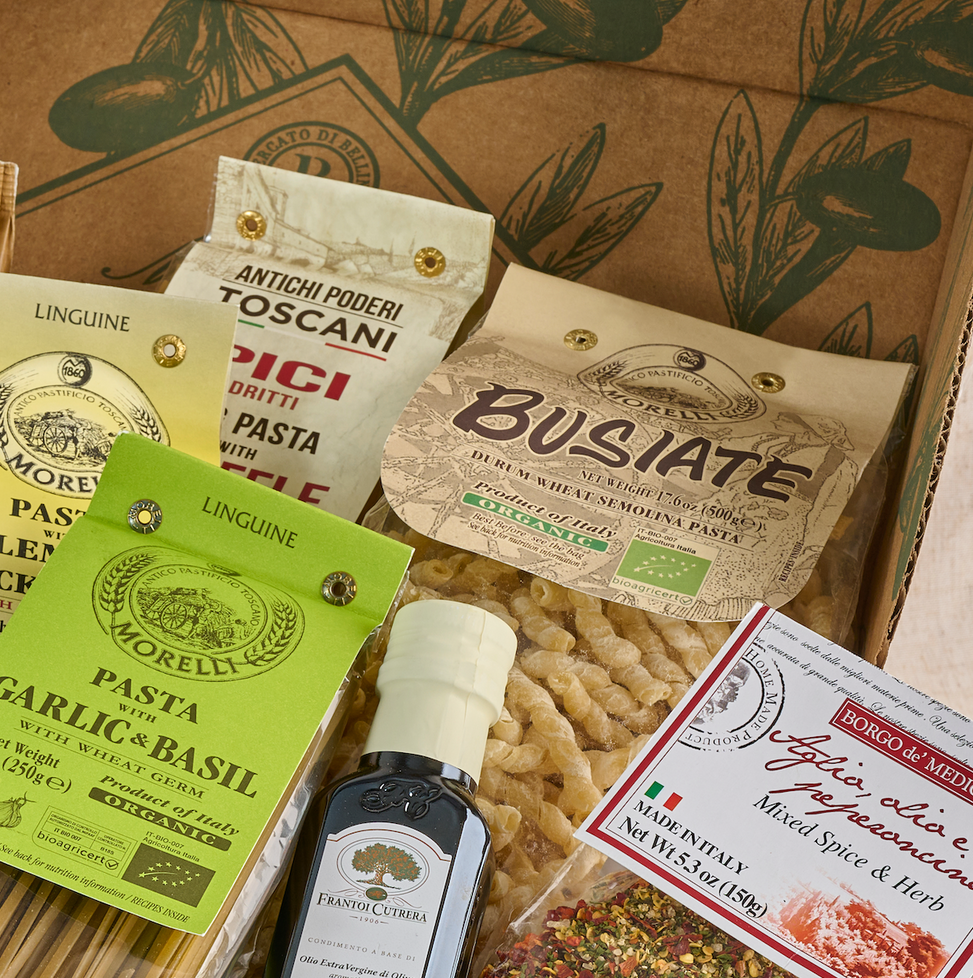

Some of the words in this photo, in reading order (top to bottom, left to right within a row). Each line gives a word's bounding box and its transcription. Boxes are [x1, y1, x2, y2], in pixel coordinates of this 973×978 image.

[253, 129, 311, 165] ERCATO
[316, 129, 338, 144] DI
[235, 265, 324, 300] ANTICHI
[323, 285, 403, 321] PODERI
[34, 302, 130, 333] LINGUINE
[219, 285, 397, 353] TOSCANI
[38, 390, 96, 405] PASTIFICIO
[228, 380, 299, 410] DRITTI
[603, 389, 719, 422] MORELLI
[232, 412, 320, 455] PASTA
[452, 381, 813, 501] BUSIATE
[6, 452, 99, 494] MORE
[579, 470, 604, 483] NET
[607, 478, 654, 498] WEIGHT
[471, 450, 530, 480] DURUM
[536, 477, 594, 501] WHEAT
[597, 495, 682, 527] SEMOLINA
[689, 522, 739, 544] PASTA
[474, 482, 545, 514] Product
[548, 513, 572, 524] of
[571, 519, 617, 538] Italy
[201, 496, 298, 549] LINGUINE
[479, 499, 592, 547] ORGANIC
[179, 567, 241, 589] PASTIFICIO
[612, 577, 679, 600] bioagricert
[112, 621, 240, 676] MORELLI
[745, 649, 774, 686] HOME
[89, 667, 199, 725] PASTA
[117, 703, 156, 724] WITH
[751, 692, 778, 731] MADE
[685, 730, 752, 746] PRODUCT
[840, 708, 904, 751] BORGO
[15, 739, 61, 769] Weight
[20, 719, 71, 746] WITH
[78, 742, 146, 775] WHEAT
[151, 772, 206, 799] GERM
[130, 732, 148, 748] &
[148, 735, 259, 799] BASIL
[100, 775, 171, 808] Product
[172, 804, 193, 822] of
[195, 812, 240, 837] Italy
[104, 794, 217, 845] ORGANIC
[880, 795, 946, 837] olio
[952, 837, 970, 851] e
[37, 830, 105, 864] bioagricert
[632, 799, 682, 836] MADE
[683, 829, 700, 845] IN
[697, 838, 749, 876] ITALY
[753, 794, 819, 837] Mixed
[815, 832, 870, 868] Spice
[871, 865, 890, 883] &
[892, 874, 946, 914] Herb
[45, 860, 80, 881] nutrition
[80, 877, 126, 899] information
[131, 896, 165, 914] RECIPES
[618, 816, 649, 842] Net
[652, 836, 676, 859] Wt
[674, 850, 701, 873] 5.3
[699, 869, 719, 887] oz
[719, 879, 770, 920] (150g)
[317, 892, 371, 913] FRANTOI
[372, 903, 427, 923] CUTRERA
[359, 916, 380, 925] 1906
[299, 954, 319, 965] Olio
[307, 937, 368, 953] CONDIMENTO
[381, 950, 402, 960] BASE
